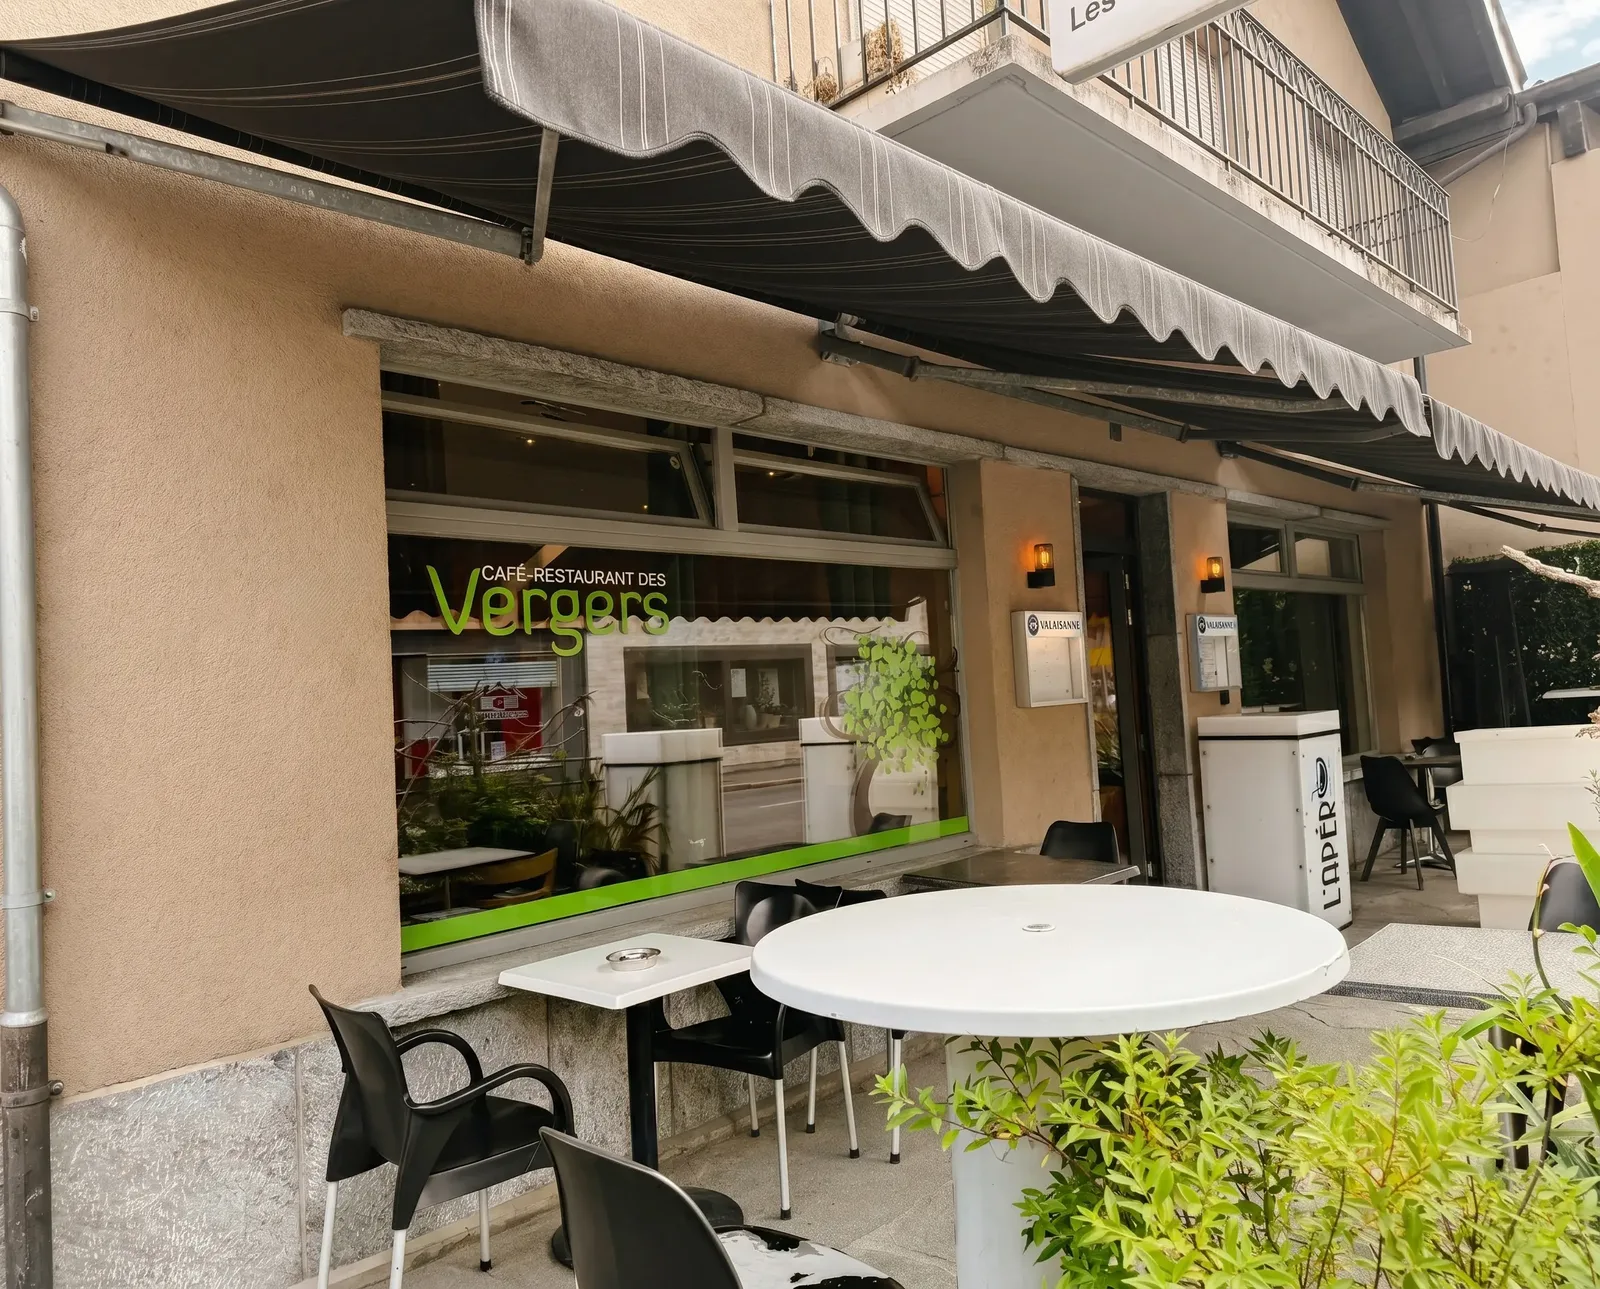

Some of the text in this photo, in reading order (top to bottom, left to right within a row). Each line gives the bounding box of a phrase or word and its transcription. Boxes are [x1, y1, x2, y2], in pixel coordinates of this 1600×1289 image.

[1070, 0, 1116, 32] Les
[481, 564, 667, 587] CAFÉ-RESTAURANT DES
[426, 564, 669, 657] Vergers
[1039, 620, 1081, 630] VALAISANNE
[1206, 620, 1234, 630] VALAISANNE
